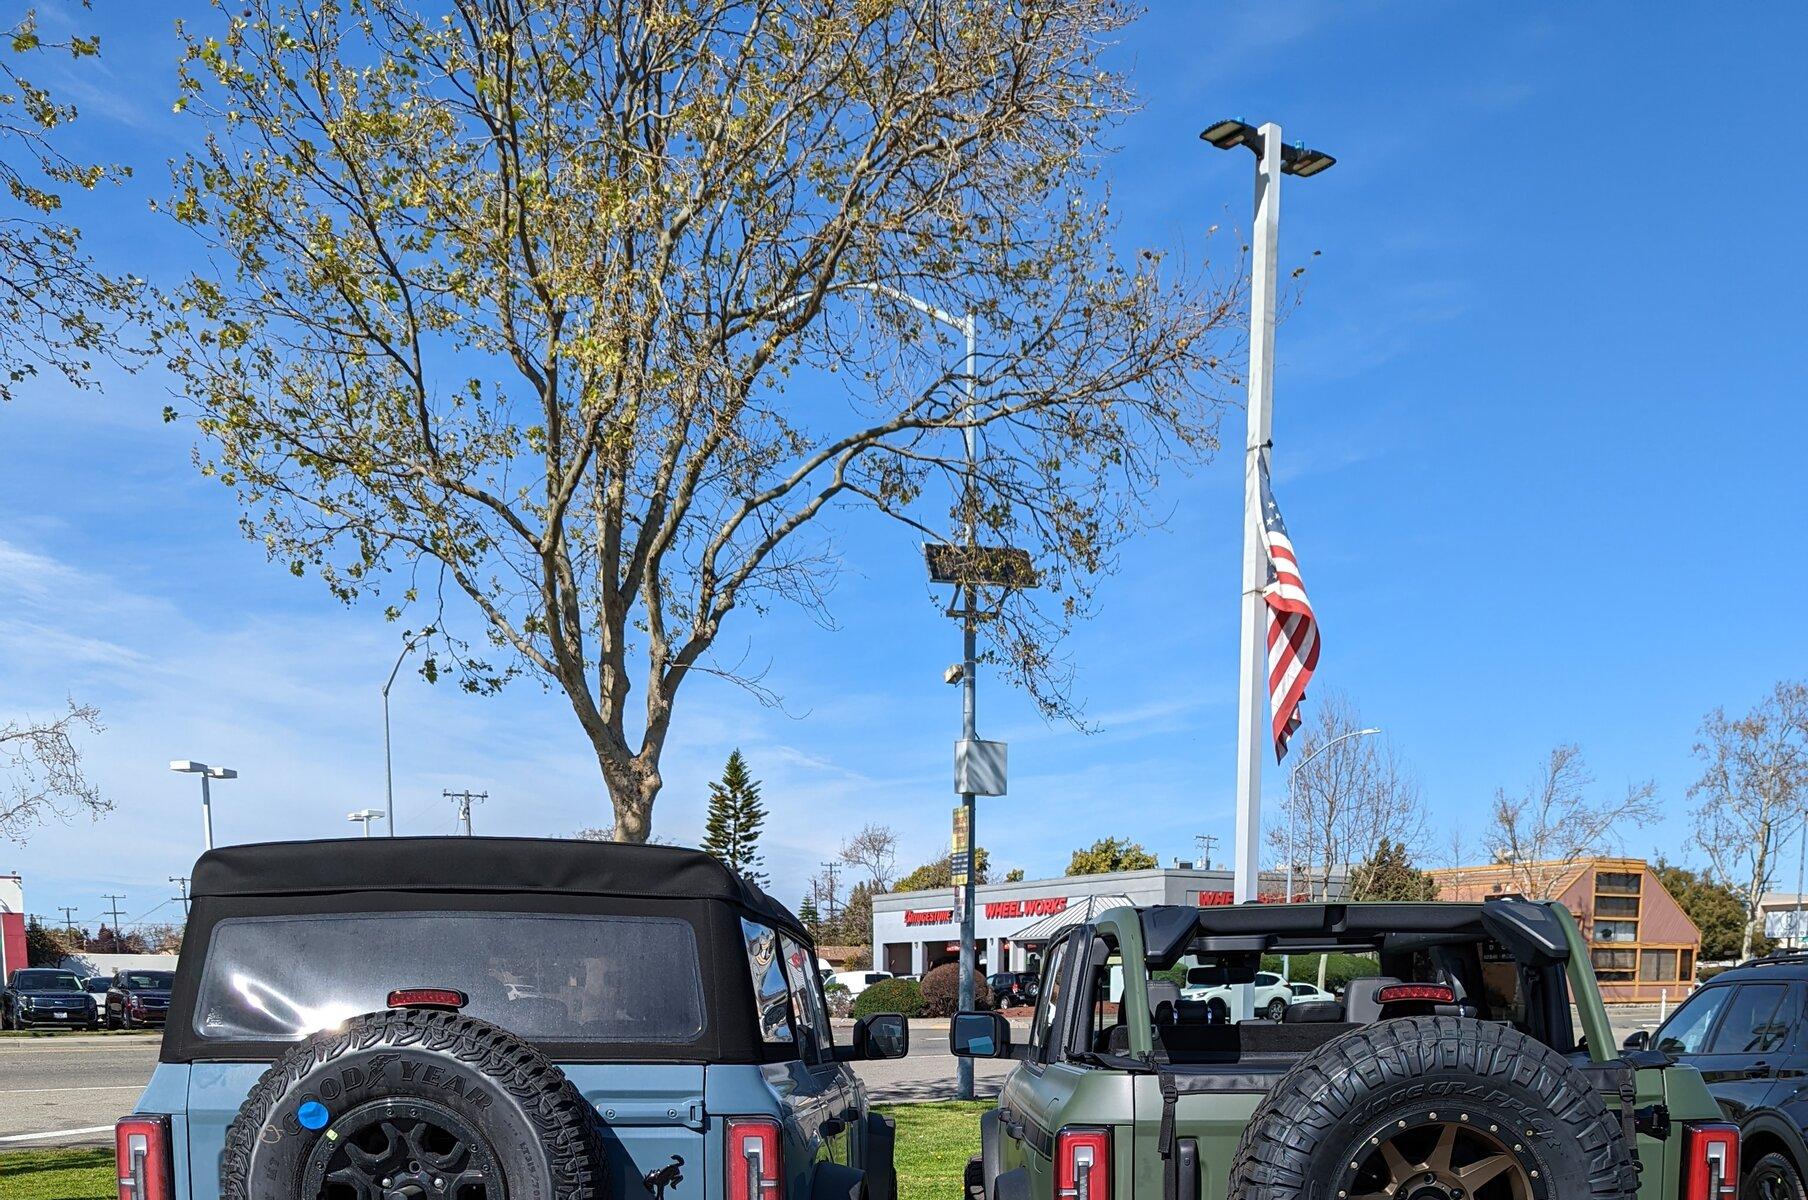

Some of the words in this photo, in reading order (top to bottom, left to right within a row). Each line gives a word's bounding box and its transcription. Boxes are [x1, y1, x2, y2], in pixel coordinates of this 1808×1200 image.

[1200, 891, 1234, 905] WHE
[985, 901, 1023, 919] WHEEL
[1024, 897, 1068, 917] WORKS
